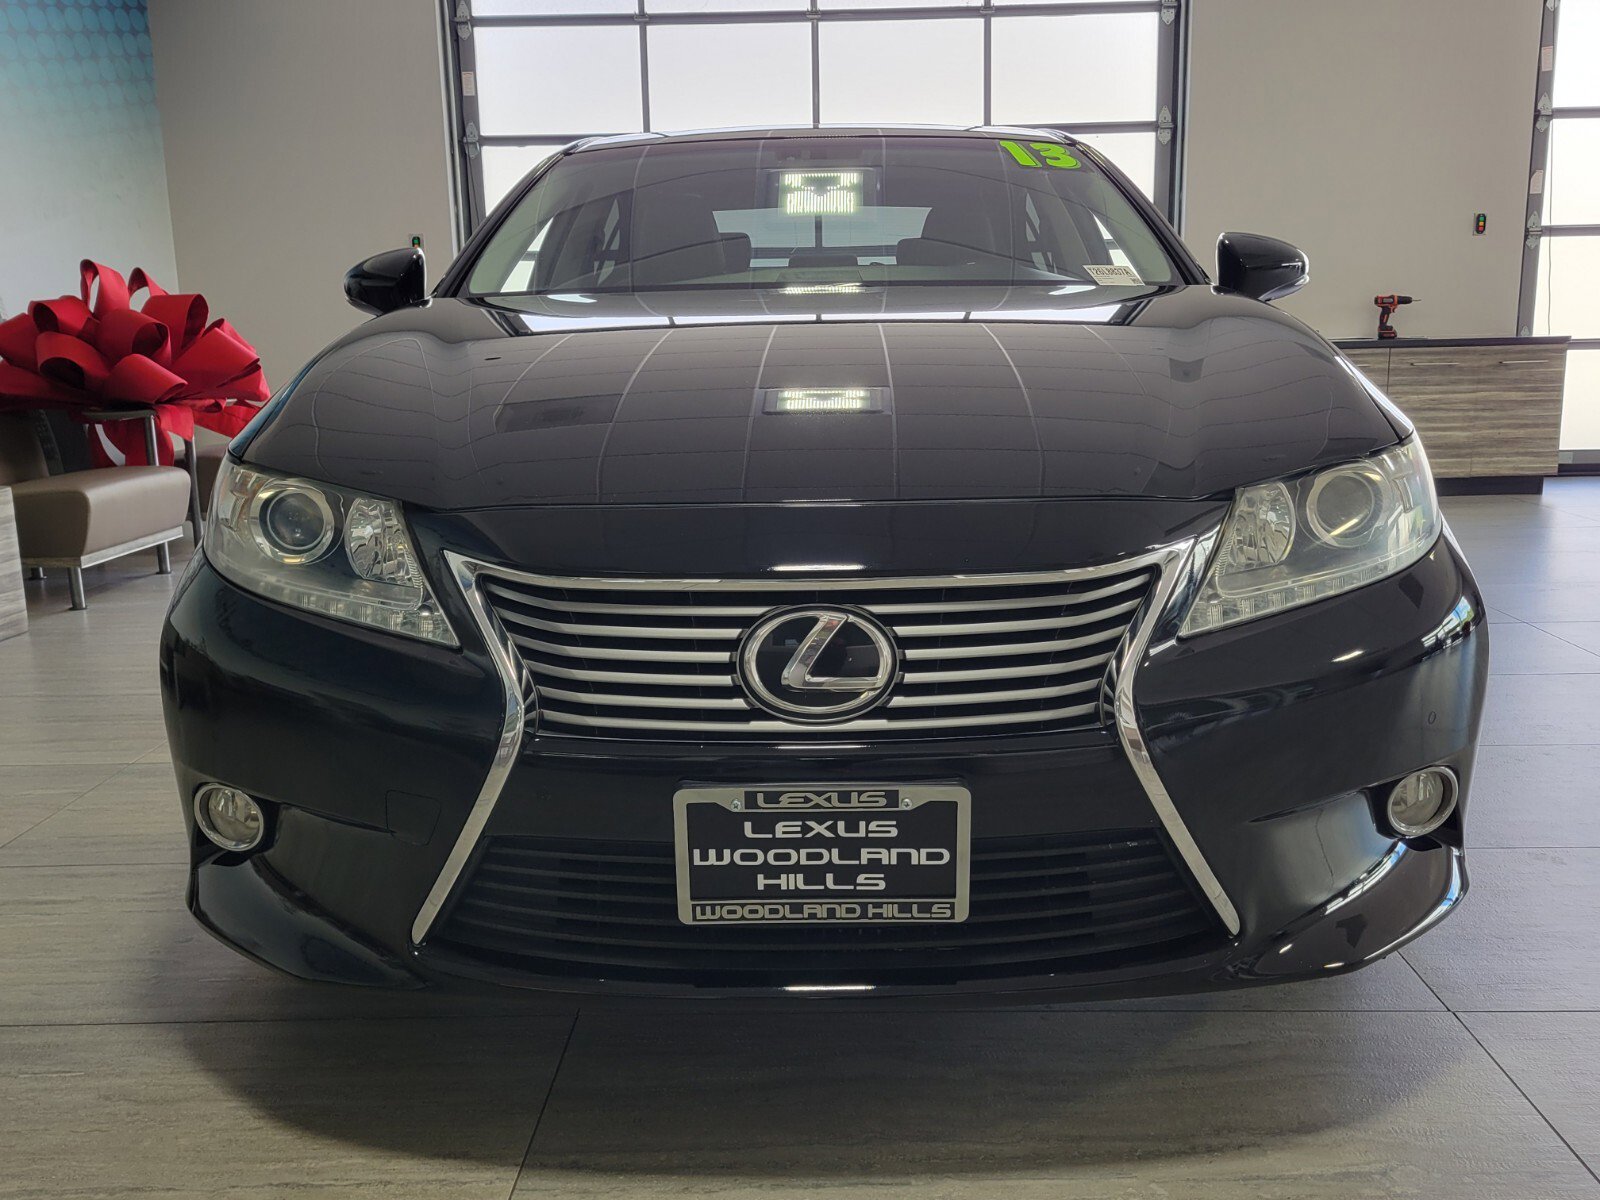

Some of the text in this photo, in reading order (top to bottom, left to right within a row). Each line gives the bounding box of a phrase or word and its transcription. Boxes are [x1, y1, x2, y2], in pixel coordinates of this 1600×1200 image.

[1000, 141, 1081, 168] 13
[757, 792, 887, 808] LEXUS
[744, 820, 898, 838] LEXUS
[693, 848, 950, 866] WOODLAND
[757, 873, 886, 890] HILLS
[696, 903, 951, 919] WOODLAND HILLS
